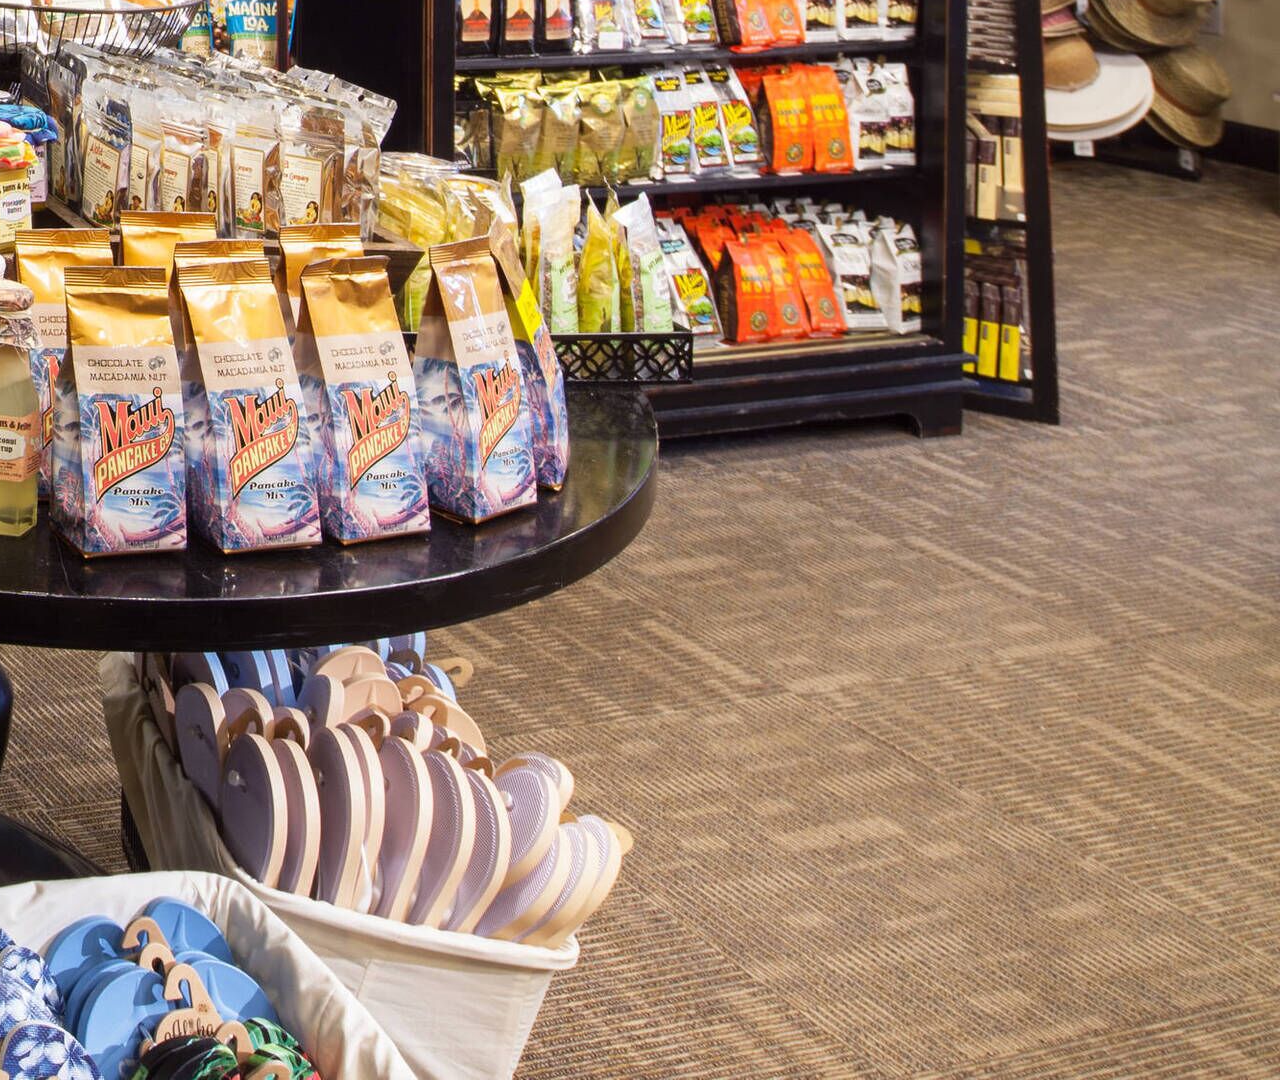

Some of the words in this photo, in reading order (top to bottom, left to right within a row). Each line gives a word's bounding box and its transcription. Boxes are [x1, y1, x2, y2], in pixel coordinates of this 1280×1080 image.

[242, 14, 270, 32] LOA
[87, 358, 144, 369] CHOCOLATE
[213, 352, 264, 365] CHOCOLATE
[334, 358, 379, 371] MACADAMIA
[380, 356, 399, 367] NUT
[89, 372, 147, 382] MACADAMIA
[148, 372, 167, 382] NUT
[216, 366, 269, 378] MACADAMIA
[268, 363, 286, 374] NUT
[96, 441, 159, 486] PANCAKE
[233, 433, 287, 482] PANCAKE
[365, 469, 408, 482] Pancake
[112, 486, 164, 497] Pancake
[249, 479, 296, 491] Pancake
[128, 497, 151, 507] Mix
[265, 491, 286, 501] Mix
